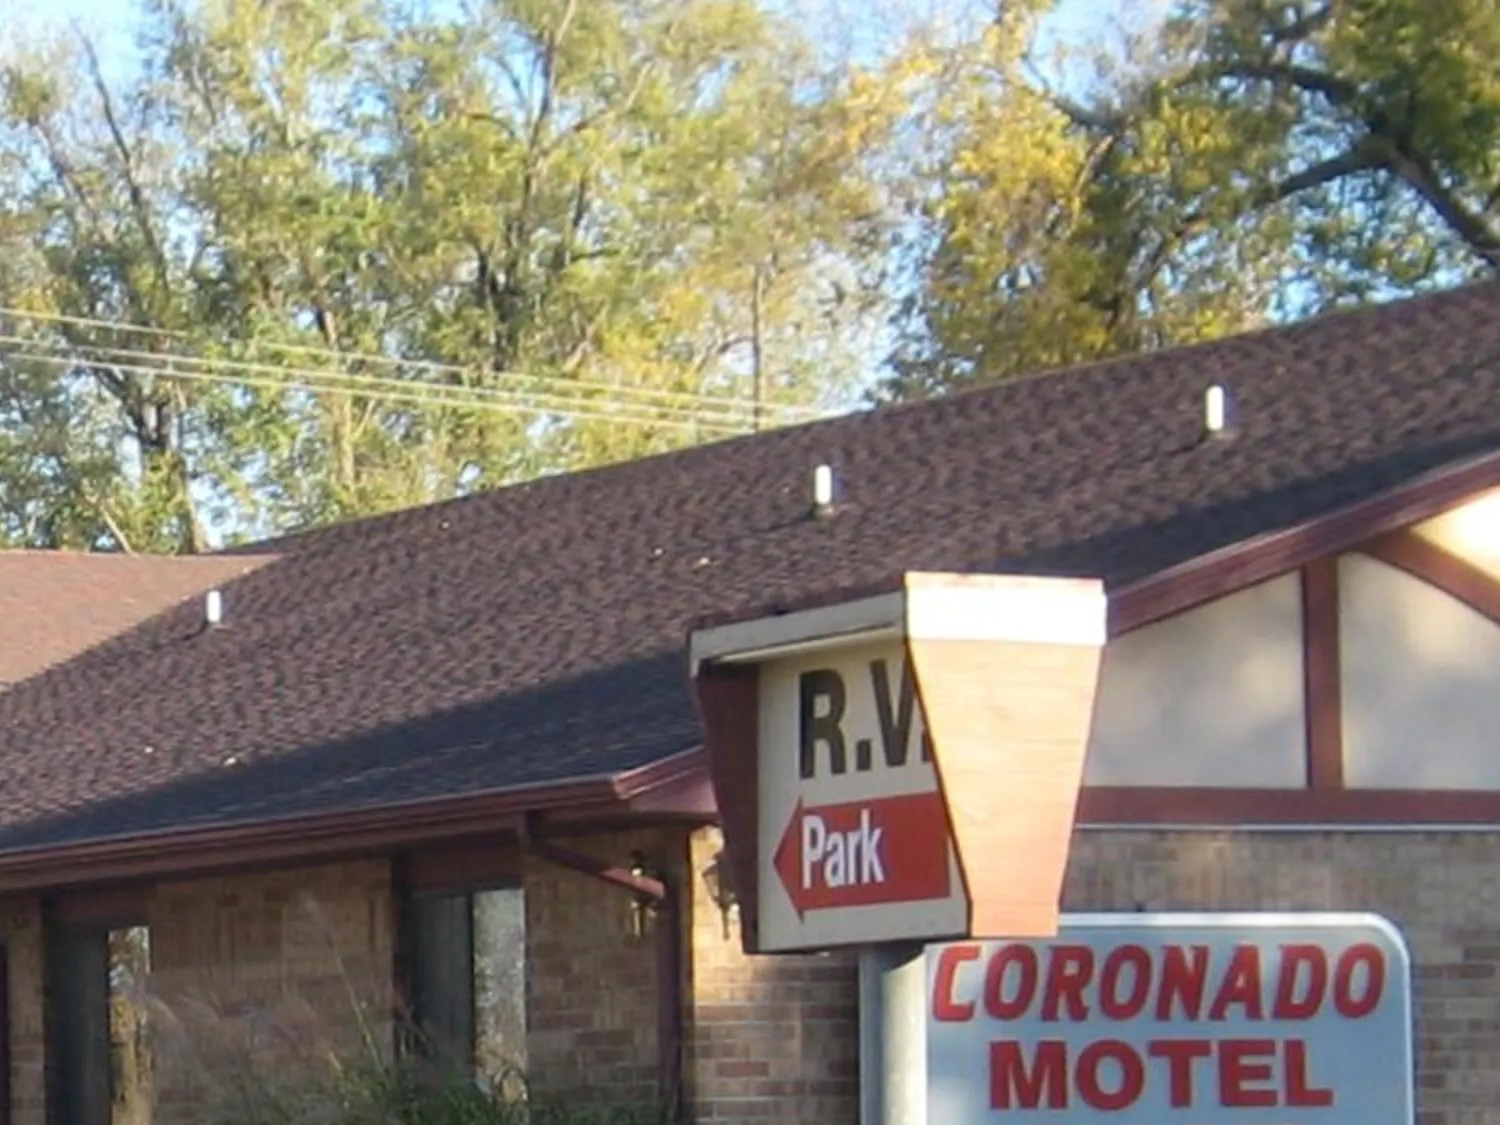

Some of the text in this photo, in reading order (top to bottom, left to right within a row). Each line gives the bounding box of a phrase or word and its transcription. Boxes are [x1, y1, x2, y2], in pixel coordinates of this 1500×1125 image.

[802, 807, 885, 889] Park
[932, 942, 1386, 1022] CORONADO
[988, 1039, 1335, 1111] MOTEL
